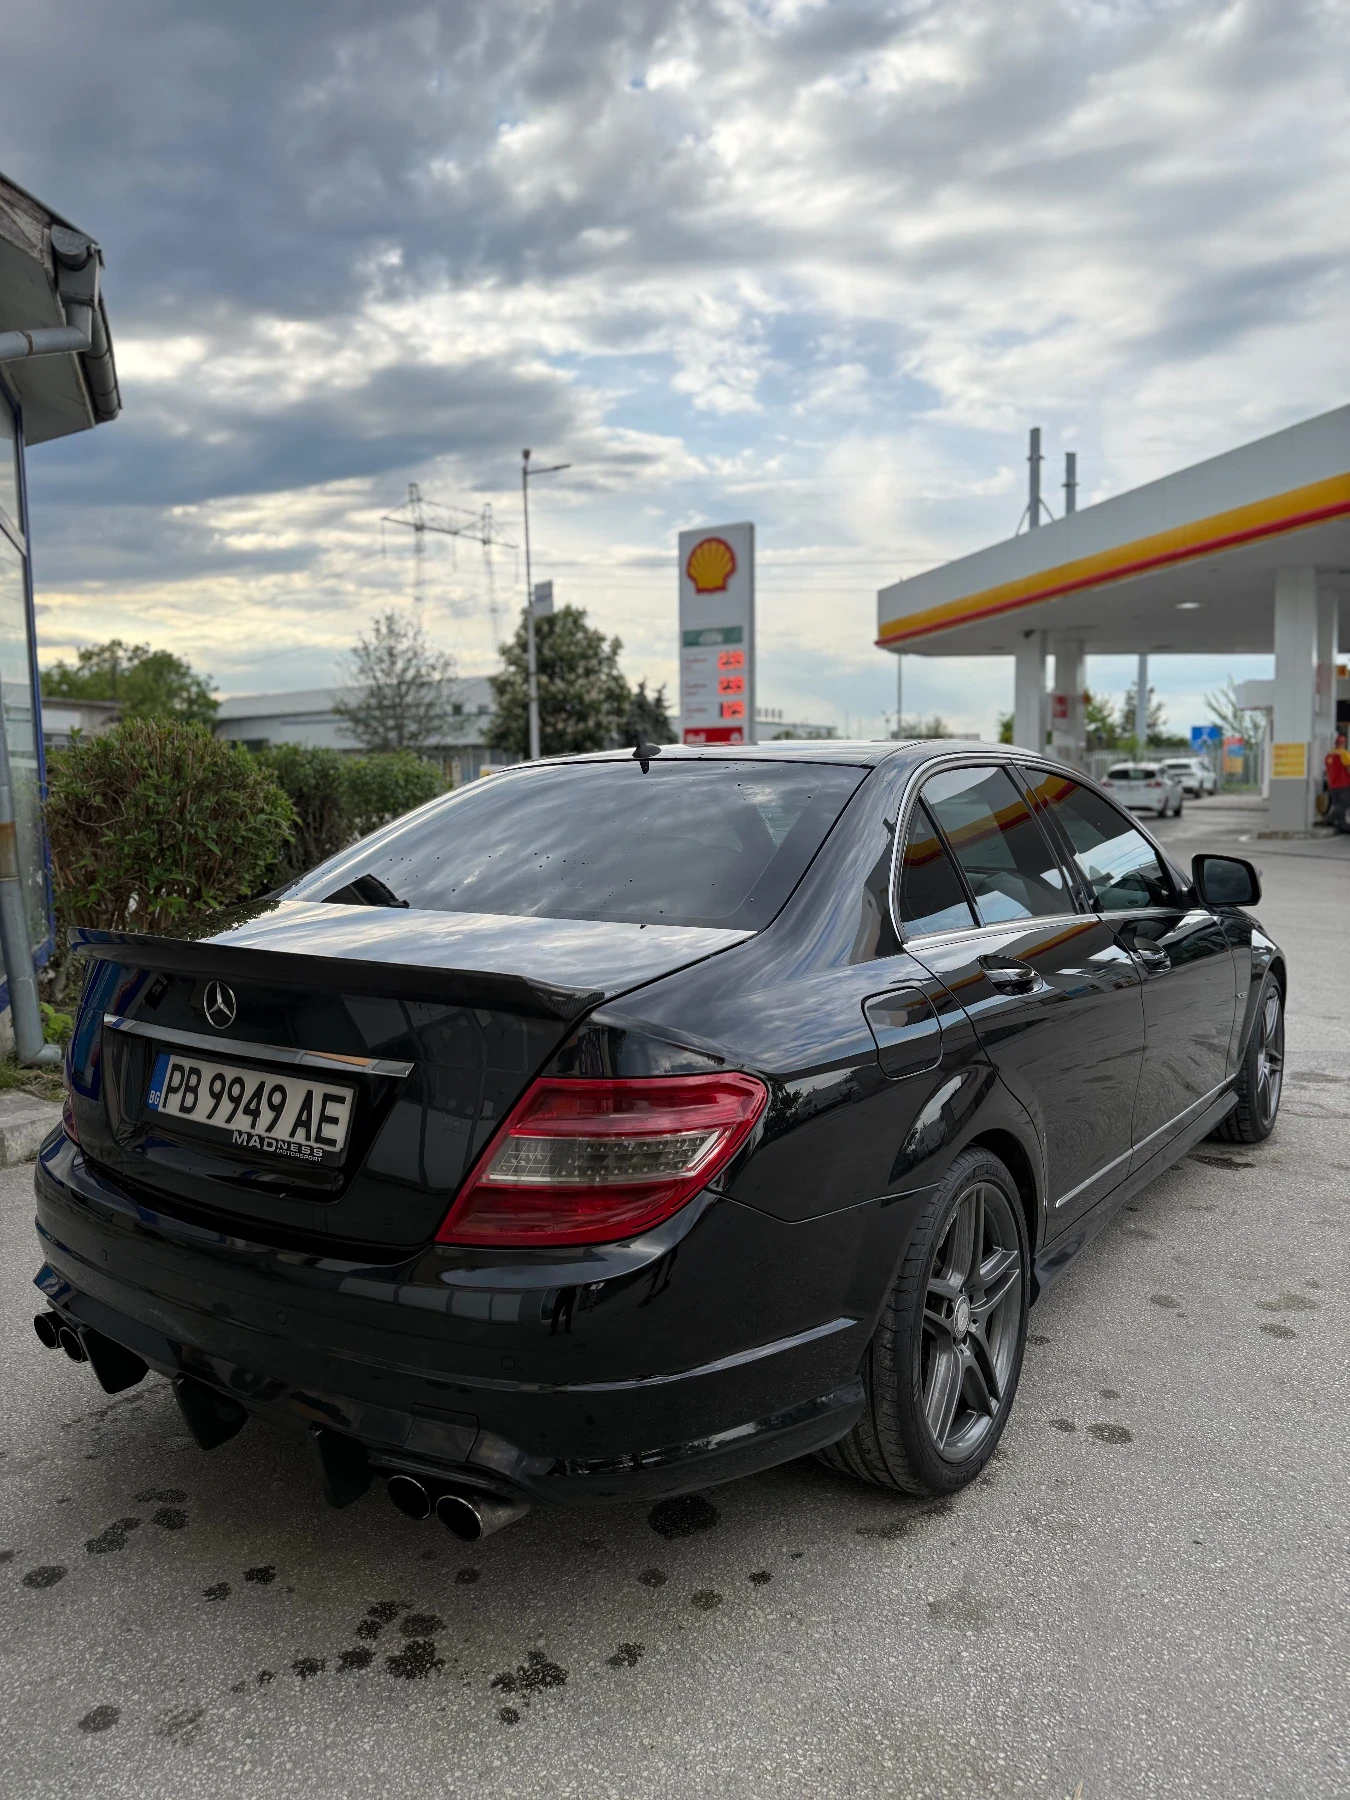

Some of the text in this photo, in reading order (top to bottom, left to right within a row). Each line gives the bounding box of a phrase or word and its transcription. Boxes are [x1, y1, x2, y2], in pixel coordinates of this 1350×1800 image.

[148, 1089, 160, 1104] BG
[162, 1063, 347, 1147] PB 9949 AE
[232, 1130, 323, 1157] MADNESS
[276, 1148, 323, 1162] MOTORSPORT
